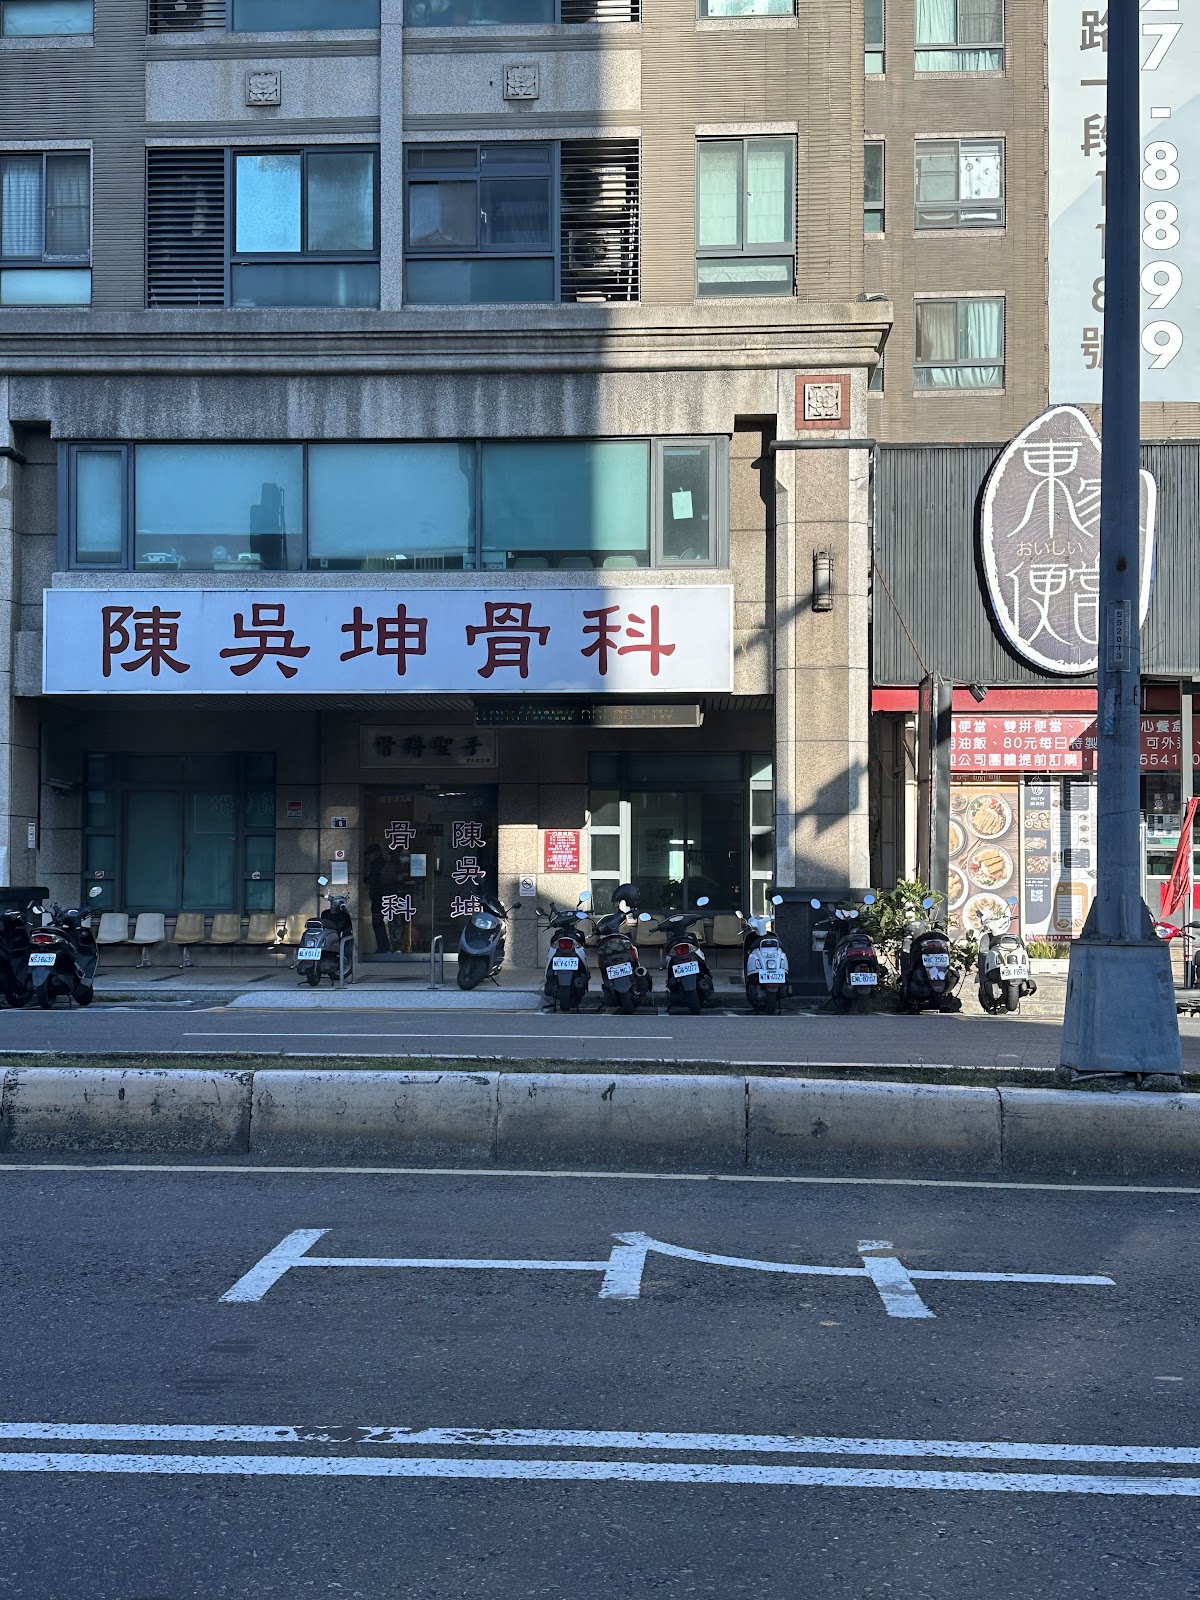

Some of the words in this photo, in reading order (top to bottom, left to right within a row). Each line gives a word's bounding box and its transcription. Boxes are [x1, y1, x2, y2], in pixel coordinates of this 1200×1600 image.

[1140, 0, 1183, 370] 7-8899
[1016, 540, 1084, 557] おいしい
[102, 602, 677, 679] 陳吳坤骨科
